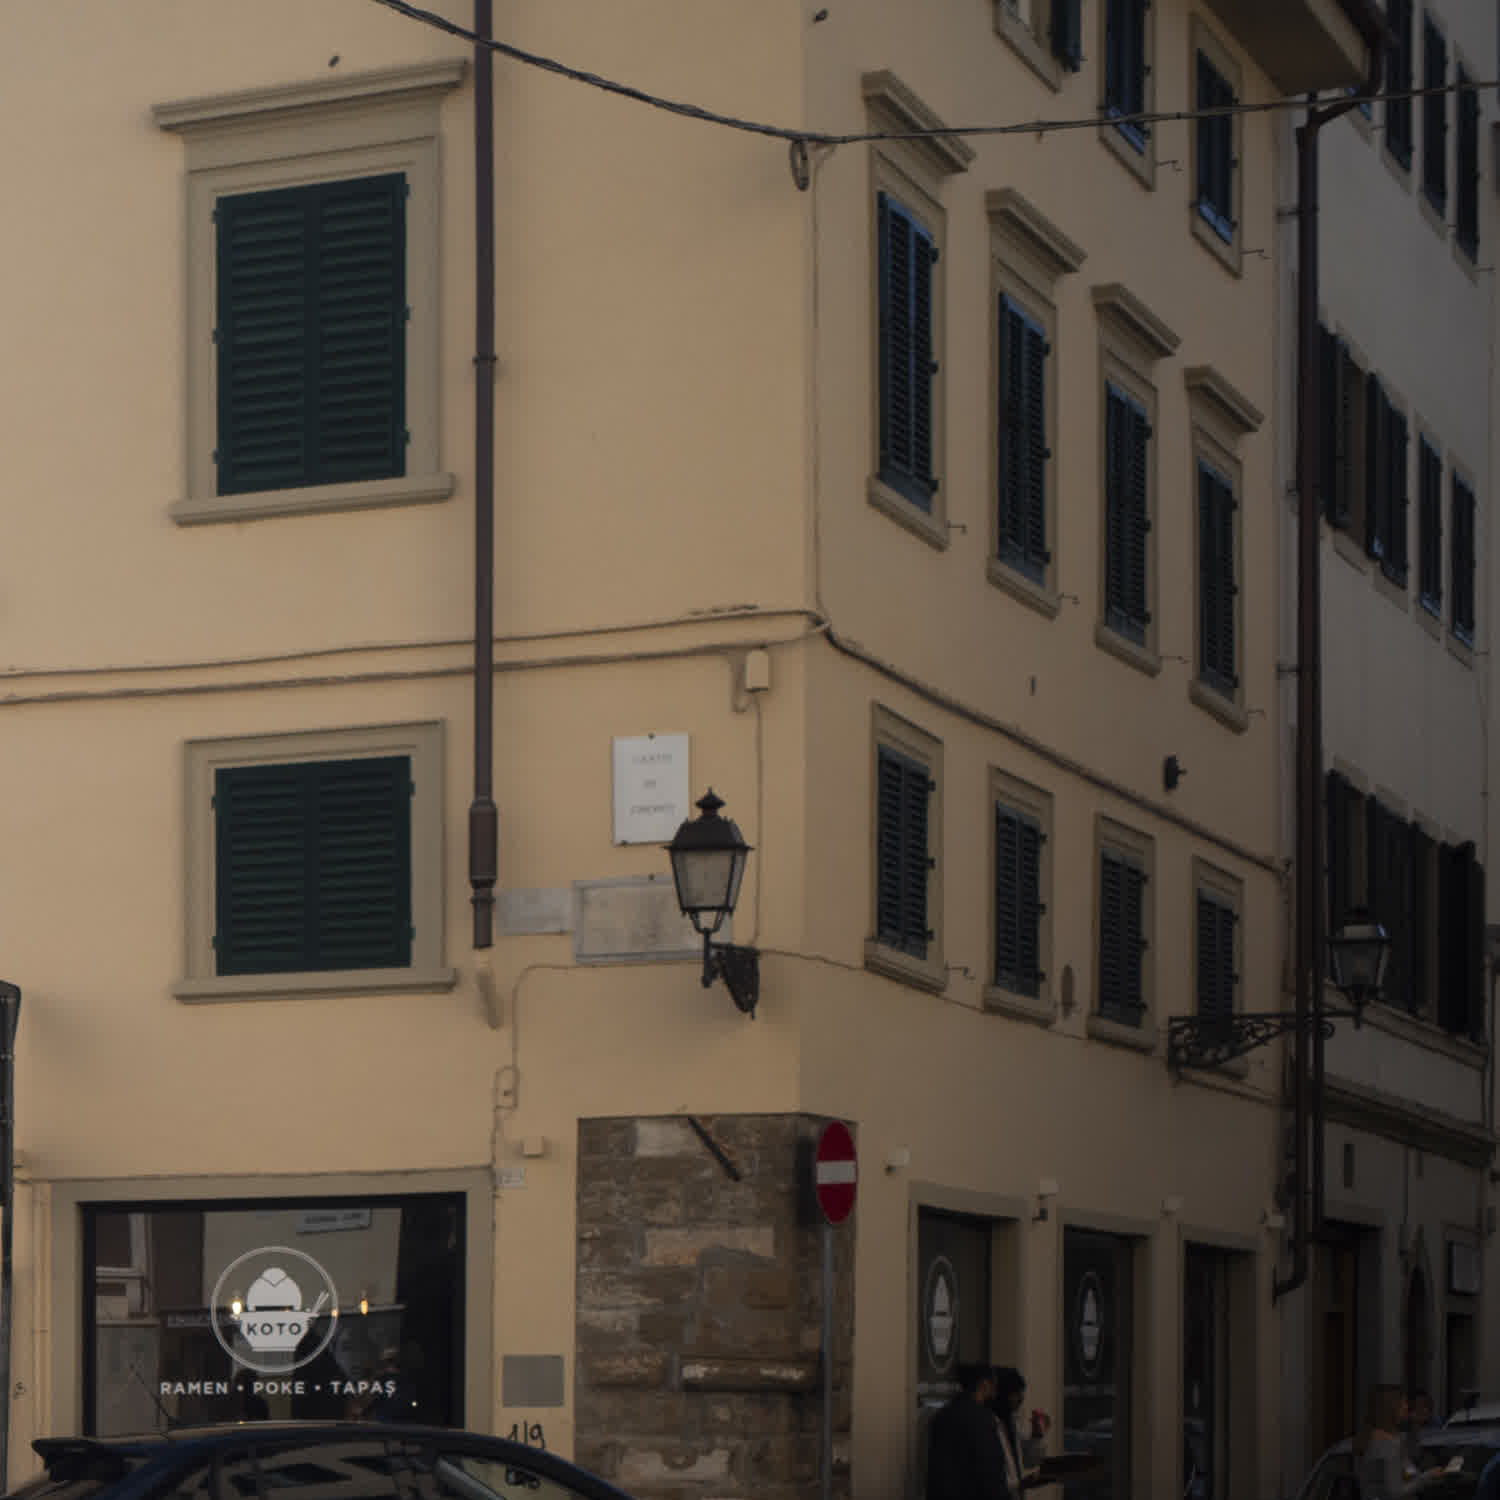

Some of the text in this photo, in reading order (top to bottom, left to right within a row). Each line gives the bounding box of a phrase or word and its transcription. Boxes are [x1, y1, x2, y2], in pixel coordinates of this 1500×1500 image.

[246, 1322, 303, 1336] KOTO
[160, 1380, 397, 1396] RAMEN POKE TAPAS
